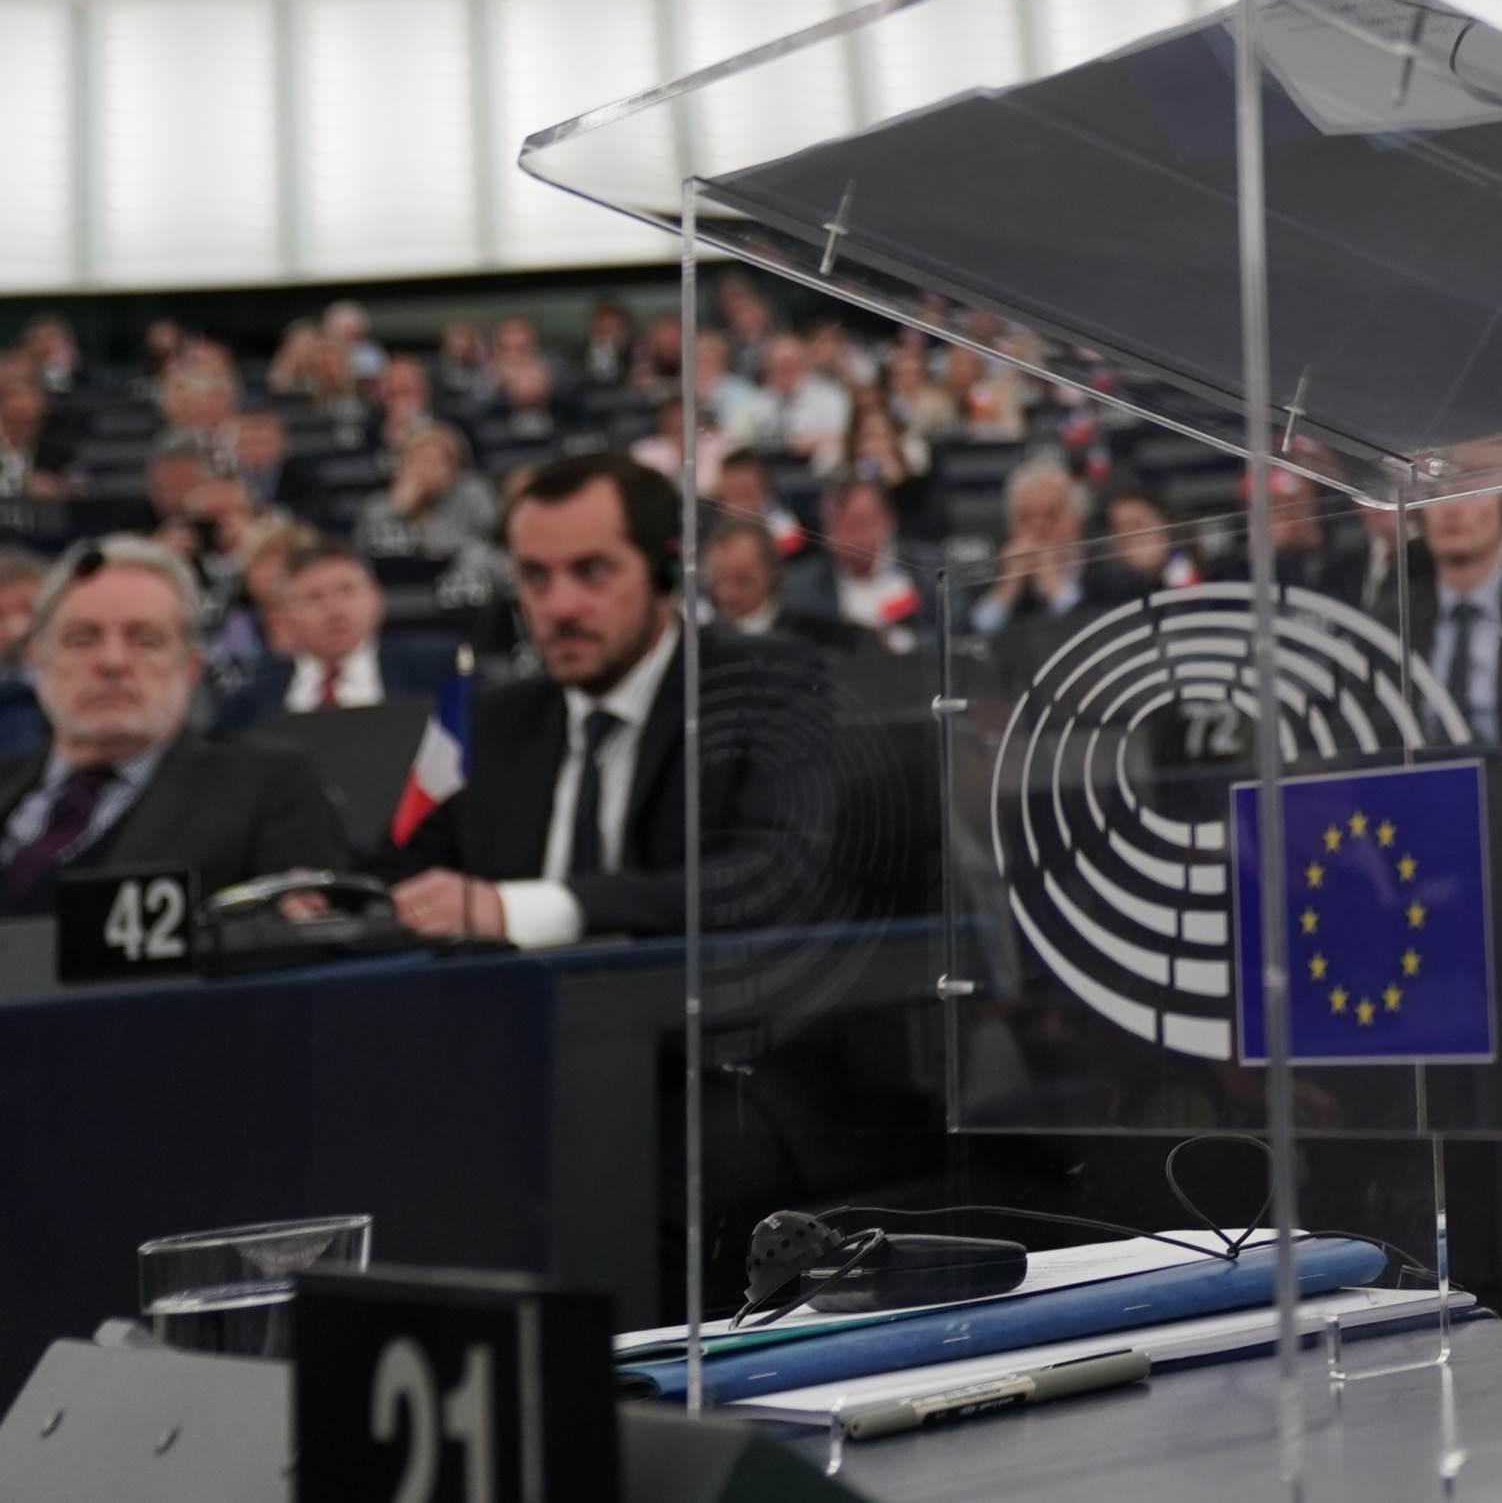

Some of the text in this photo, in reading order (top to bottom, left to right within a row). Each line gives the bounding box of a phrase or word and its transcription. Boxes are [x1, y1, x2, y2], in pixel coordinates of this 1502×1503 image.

[1181, 701, 1244, 756] 72
[103, 878, 186, 961] 42
[370, 1337, 495, 1503] 21
